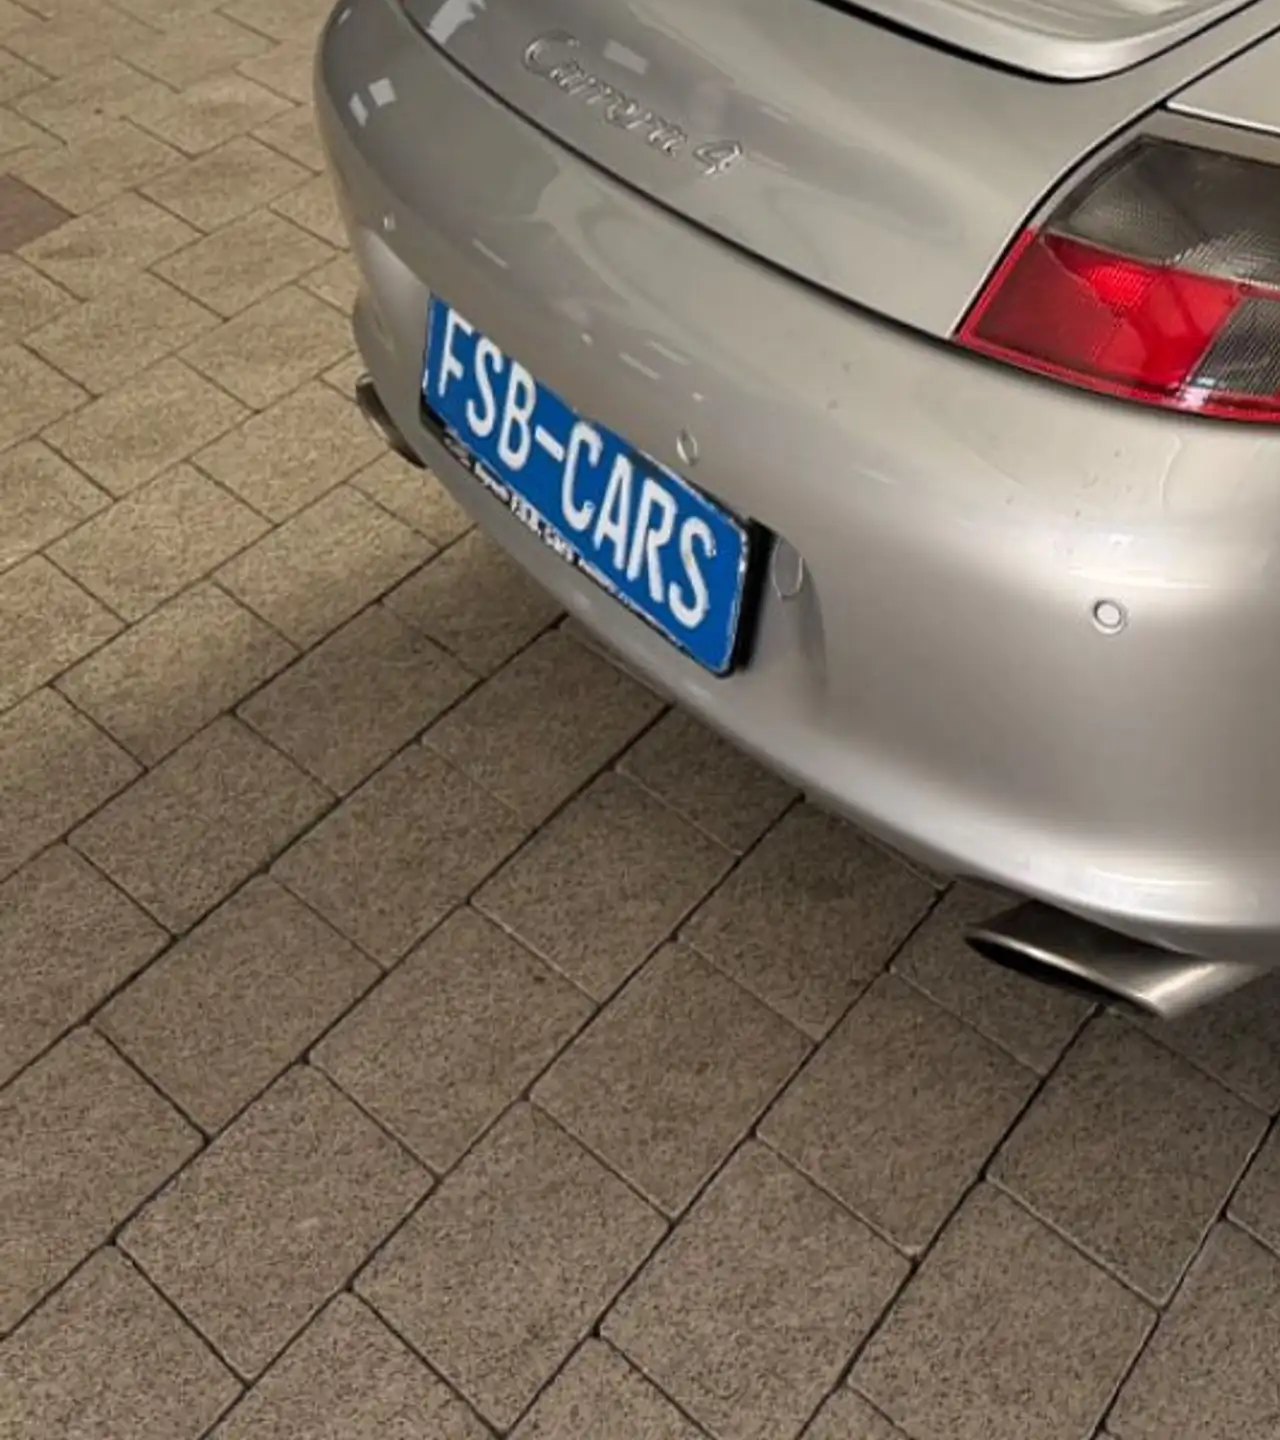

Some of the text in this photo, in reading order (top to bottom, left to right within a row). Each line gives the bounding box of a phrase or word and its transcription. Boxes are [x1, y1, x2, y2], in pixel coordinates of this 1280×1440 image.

[522, 28, 743, 179] Carrera 4
[438, 307, 717, 629] FSB-CARS
